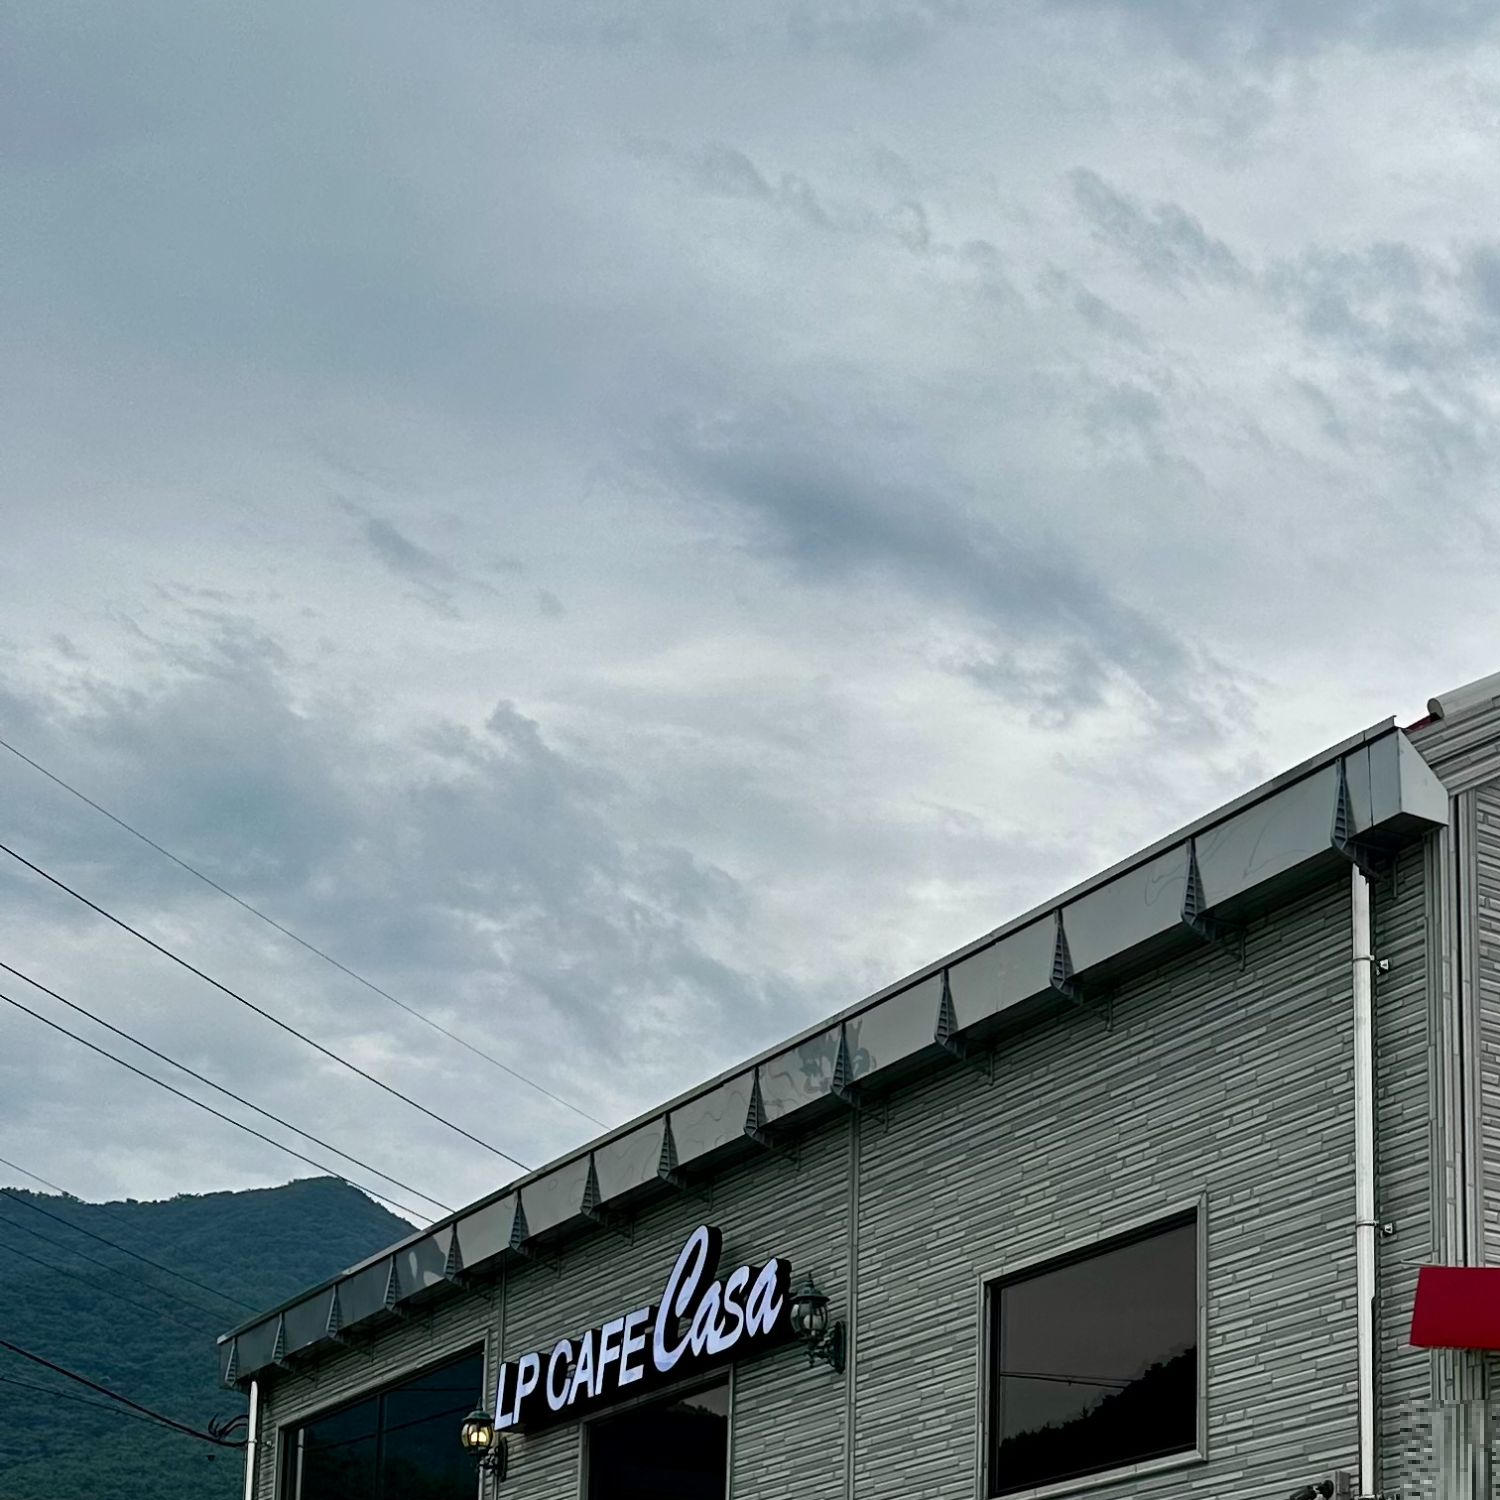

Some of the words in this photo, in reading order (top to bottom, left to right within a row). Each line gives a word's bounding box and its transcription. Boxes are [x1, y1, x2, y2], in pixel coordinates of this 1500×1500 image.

[494, 1352, 540, 1432] LP
[546, 1306, 651, 1411] CAFE
[653, 1224, 784, 1373] Casa
